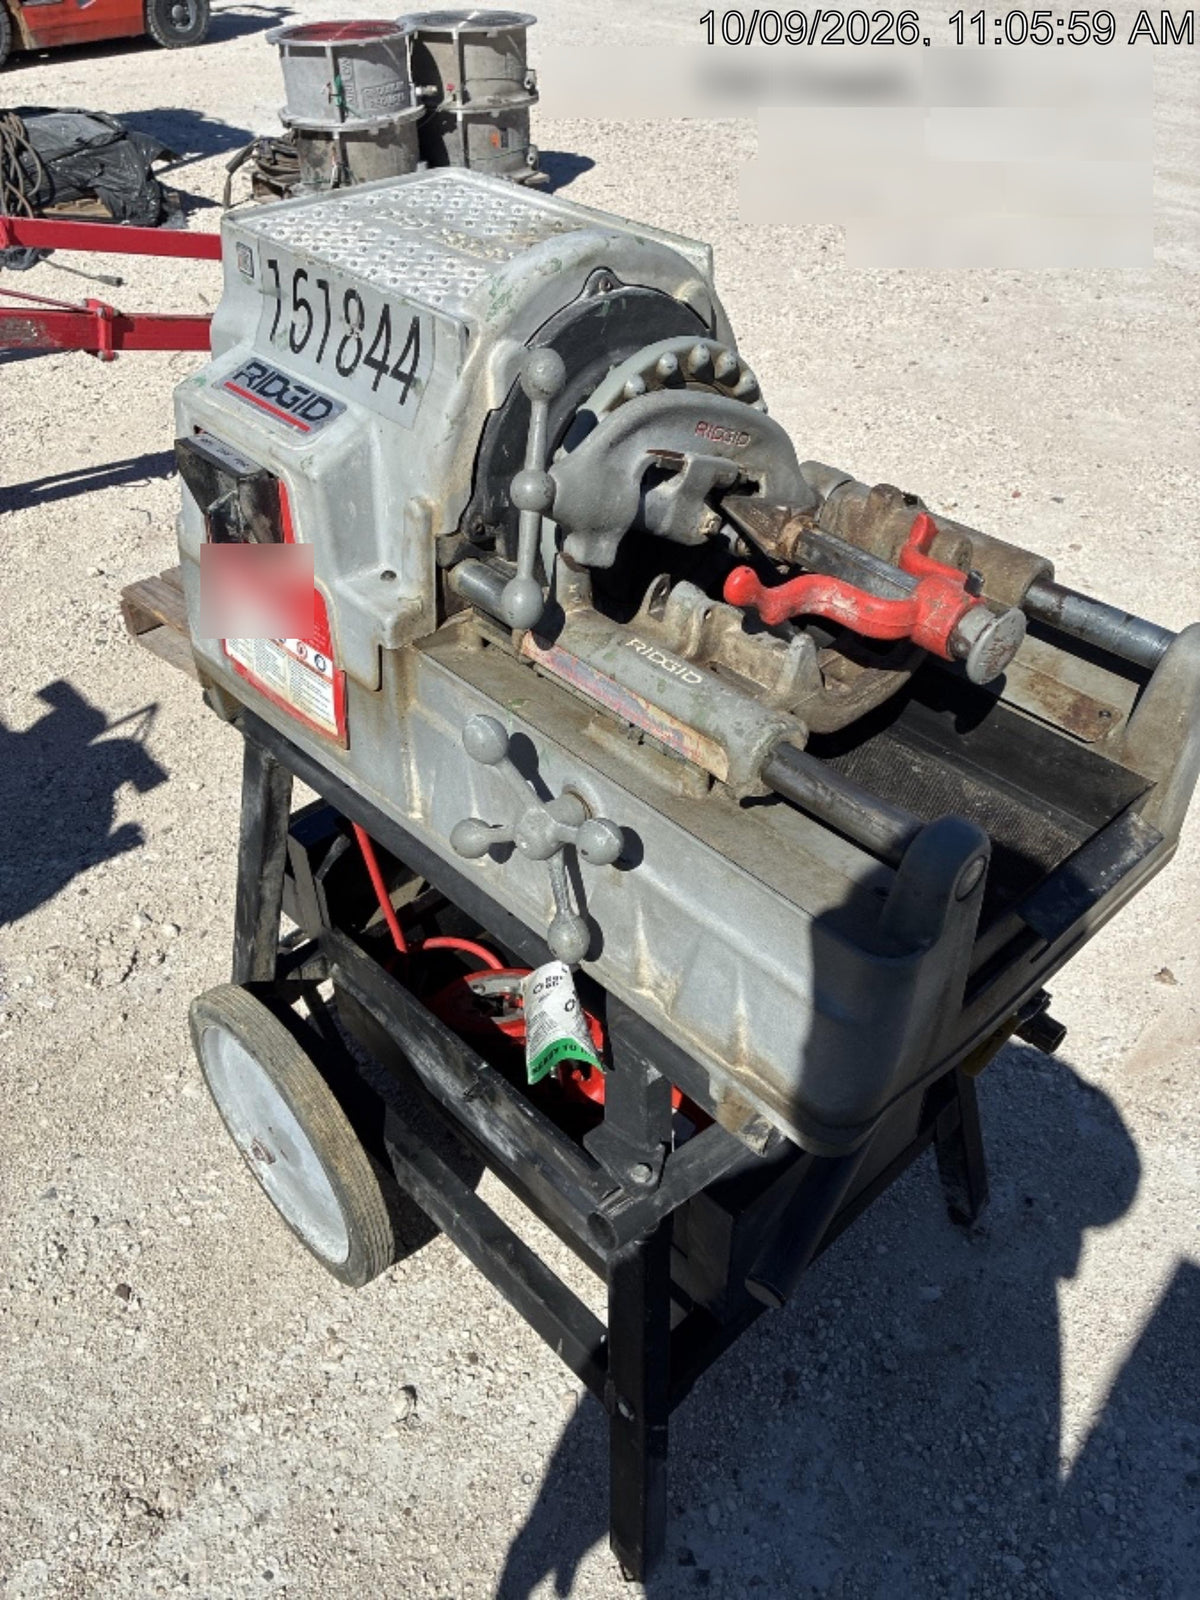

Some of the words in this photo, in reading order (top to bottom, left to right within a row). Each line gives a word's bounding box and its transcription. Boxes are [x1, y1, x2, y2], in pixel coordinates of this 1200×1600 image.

[232, 361, 334, 422] RIDGID
[694, 420, 752, 447] RIDGID
[624, 637, 703, 684] RIDGID
